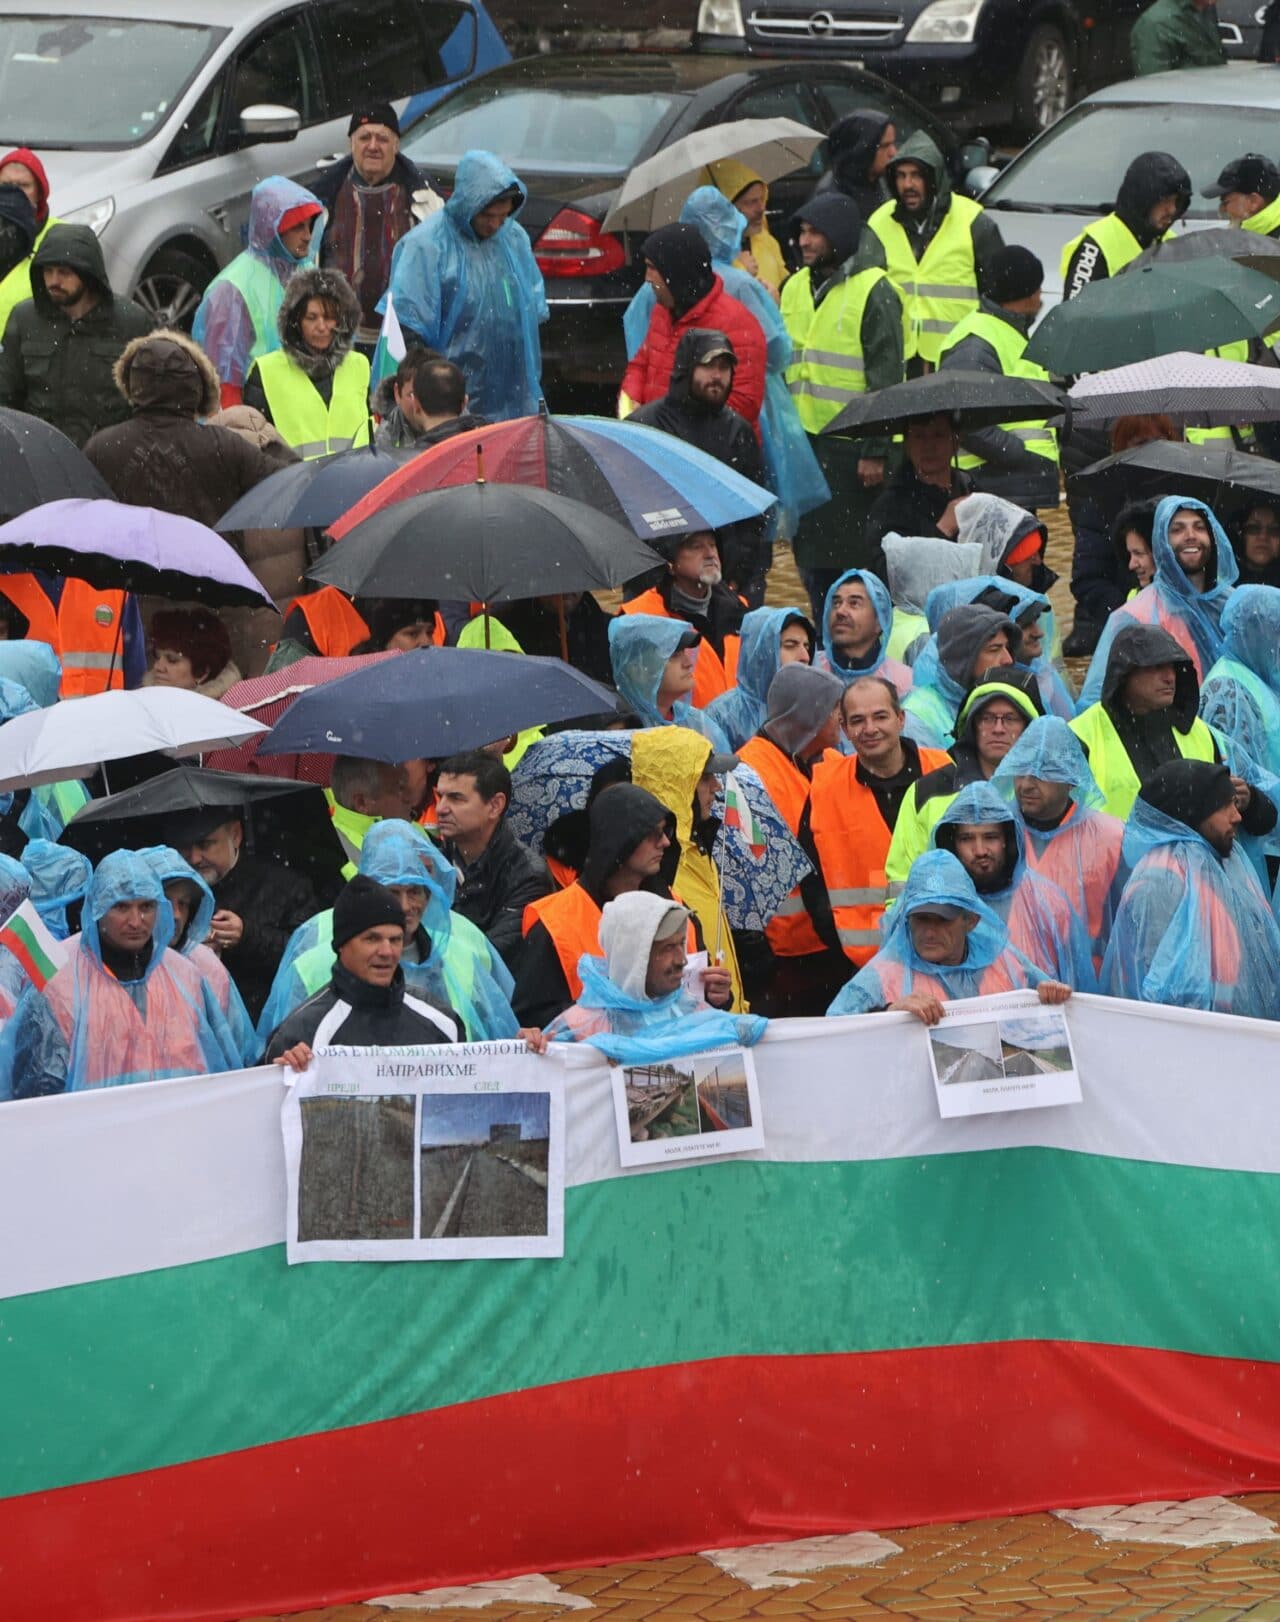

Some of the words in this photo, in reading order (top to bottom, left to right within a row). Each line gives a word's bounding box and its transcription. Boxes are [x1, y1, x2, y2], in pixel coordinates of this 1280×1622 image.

[316, 1047, 347, 1057] ОВА
[462, 1042, 510, 1057] КОЯТО
[376, 1063, 477, 1077] НАПРАВИХМЕ
[327, 1083, 360, 1093] ПРЕДИ
